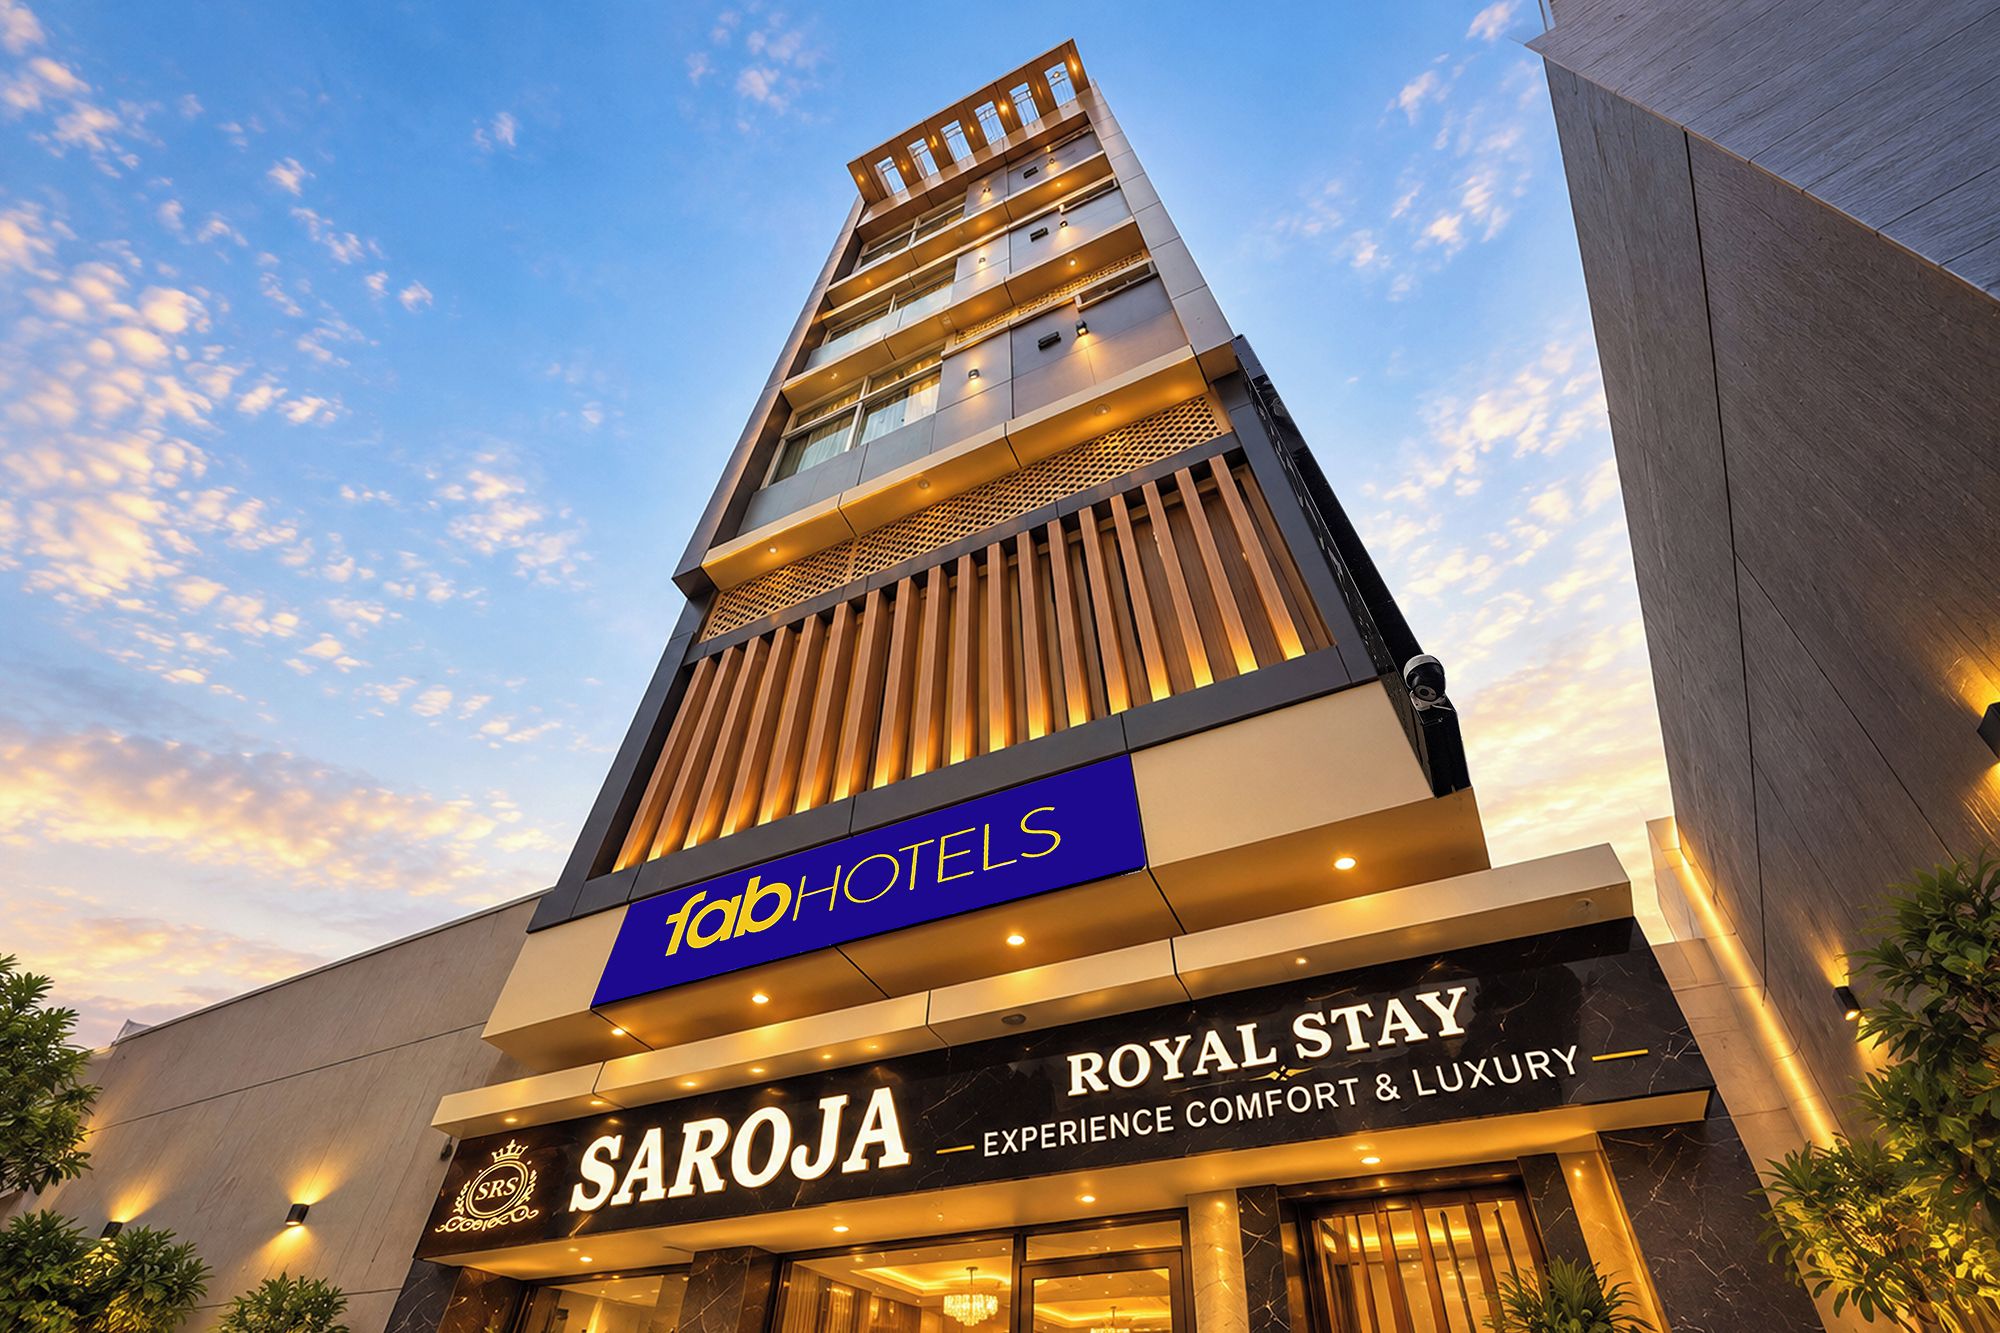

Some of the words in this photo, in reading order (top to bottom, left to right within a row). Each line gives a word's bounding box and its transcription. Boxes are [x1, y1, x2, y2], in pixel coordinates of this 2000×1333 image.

[665, 806, 1062, 957] fabHOTELS
[1066, 1022, 1277, 1097] ROYAL
[1292, 986, 1467, 1059] STAY
[569, 1086, 911, 1213] SAROJA
[983, 1106, 1175, 1158] EXPERIENCE
[1186, 1078, 1359, 1129] COMFORT
[1375, 1073, 1401, 1101] &
[1413, 1045, 1578, 1096] LUXURY
[475, 1177, 520, 1201] SRS
